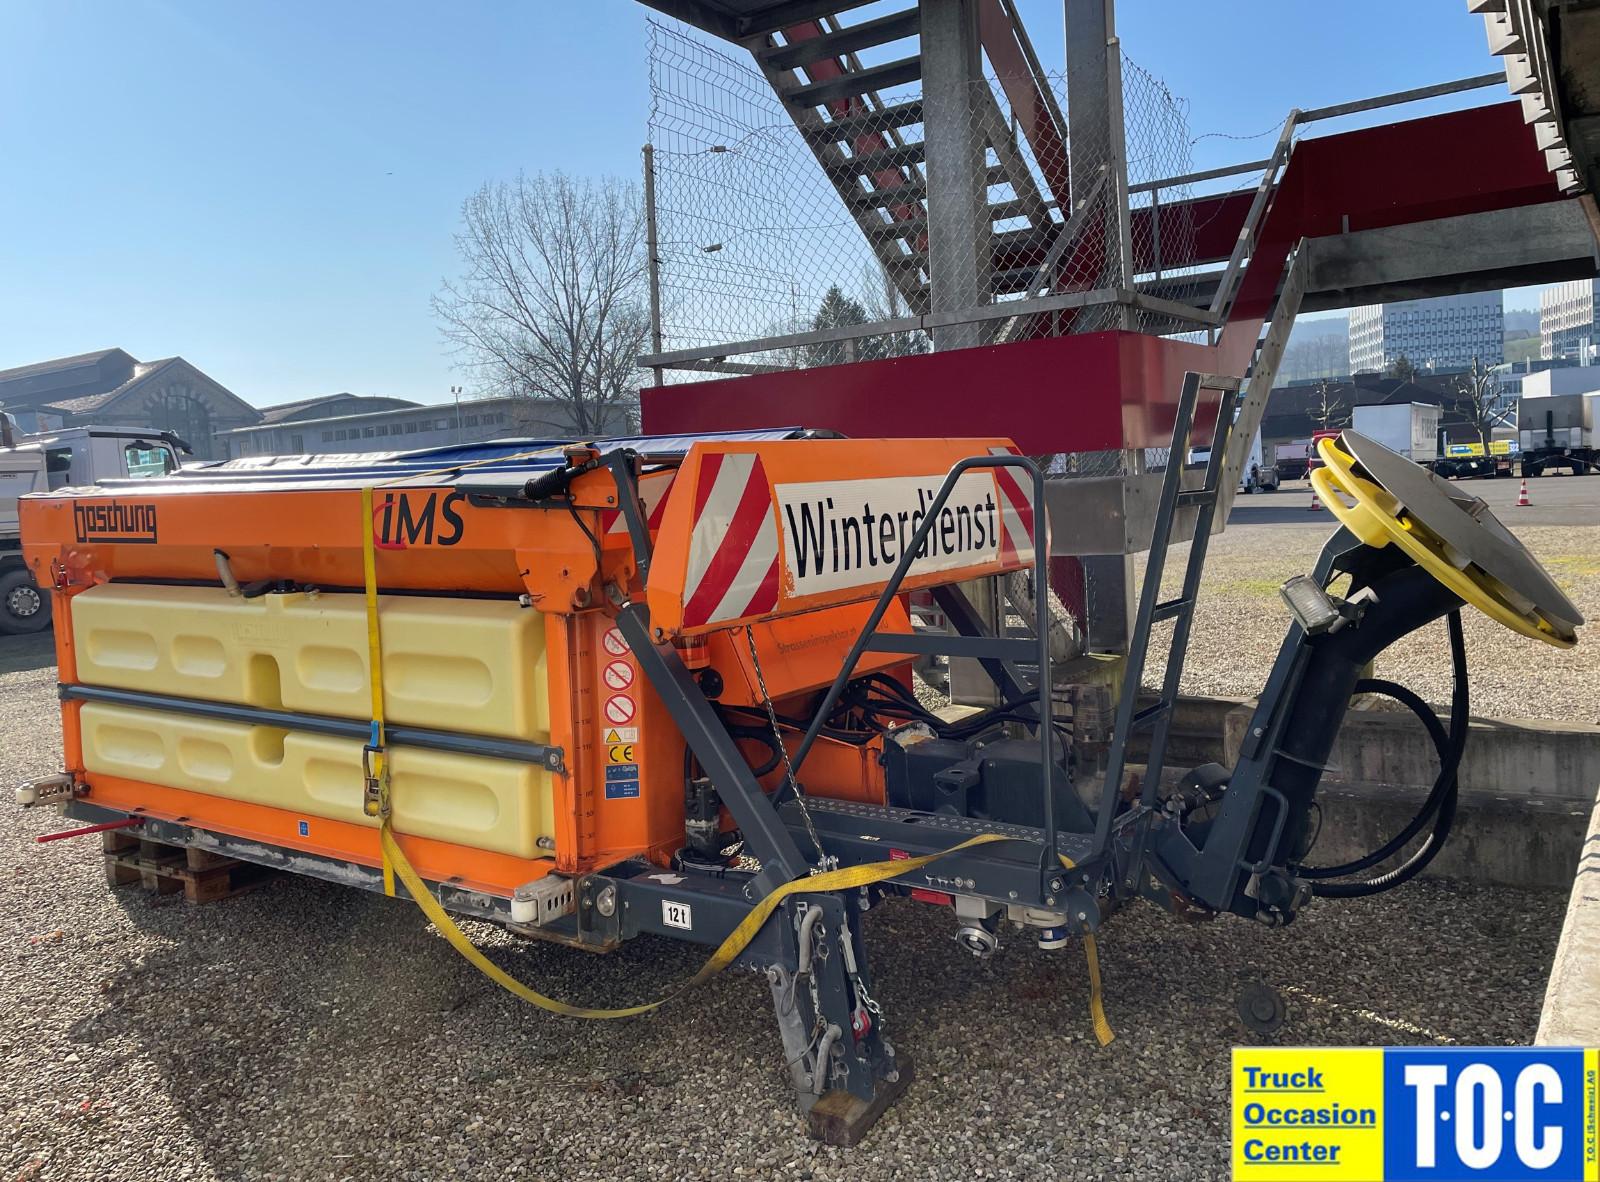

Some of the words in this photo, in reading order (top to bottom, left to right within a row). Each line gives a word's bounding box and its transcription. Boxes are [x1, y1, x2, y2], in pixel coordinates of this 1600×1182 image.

[73, 499, 158, 545] boschung
[785, 488, 995, 577] Winterdienst
[668, 906, 679, 923] 12
[681, 909, 686, 924] t
